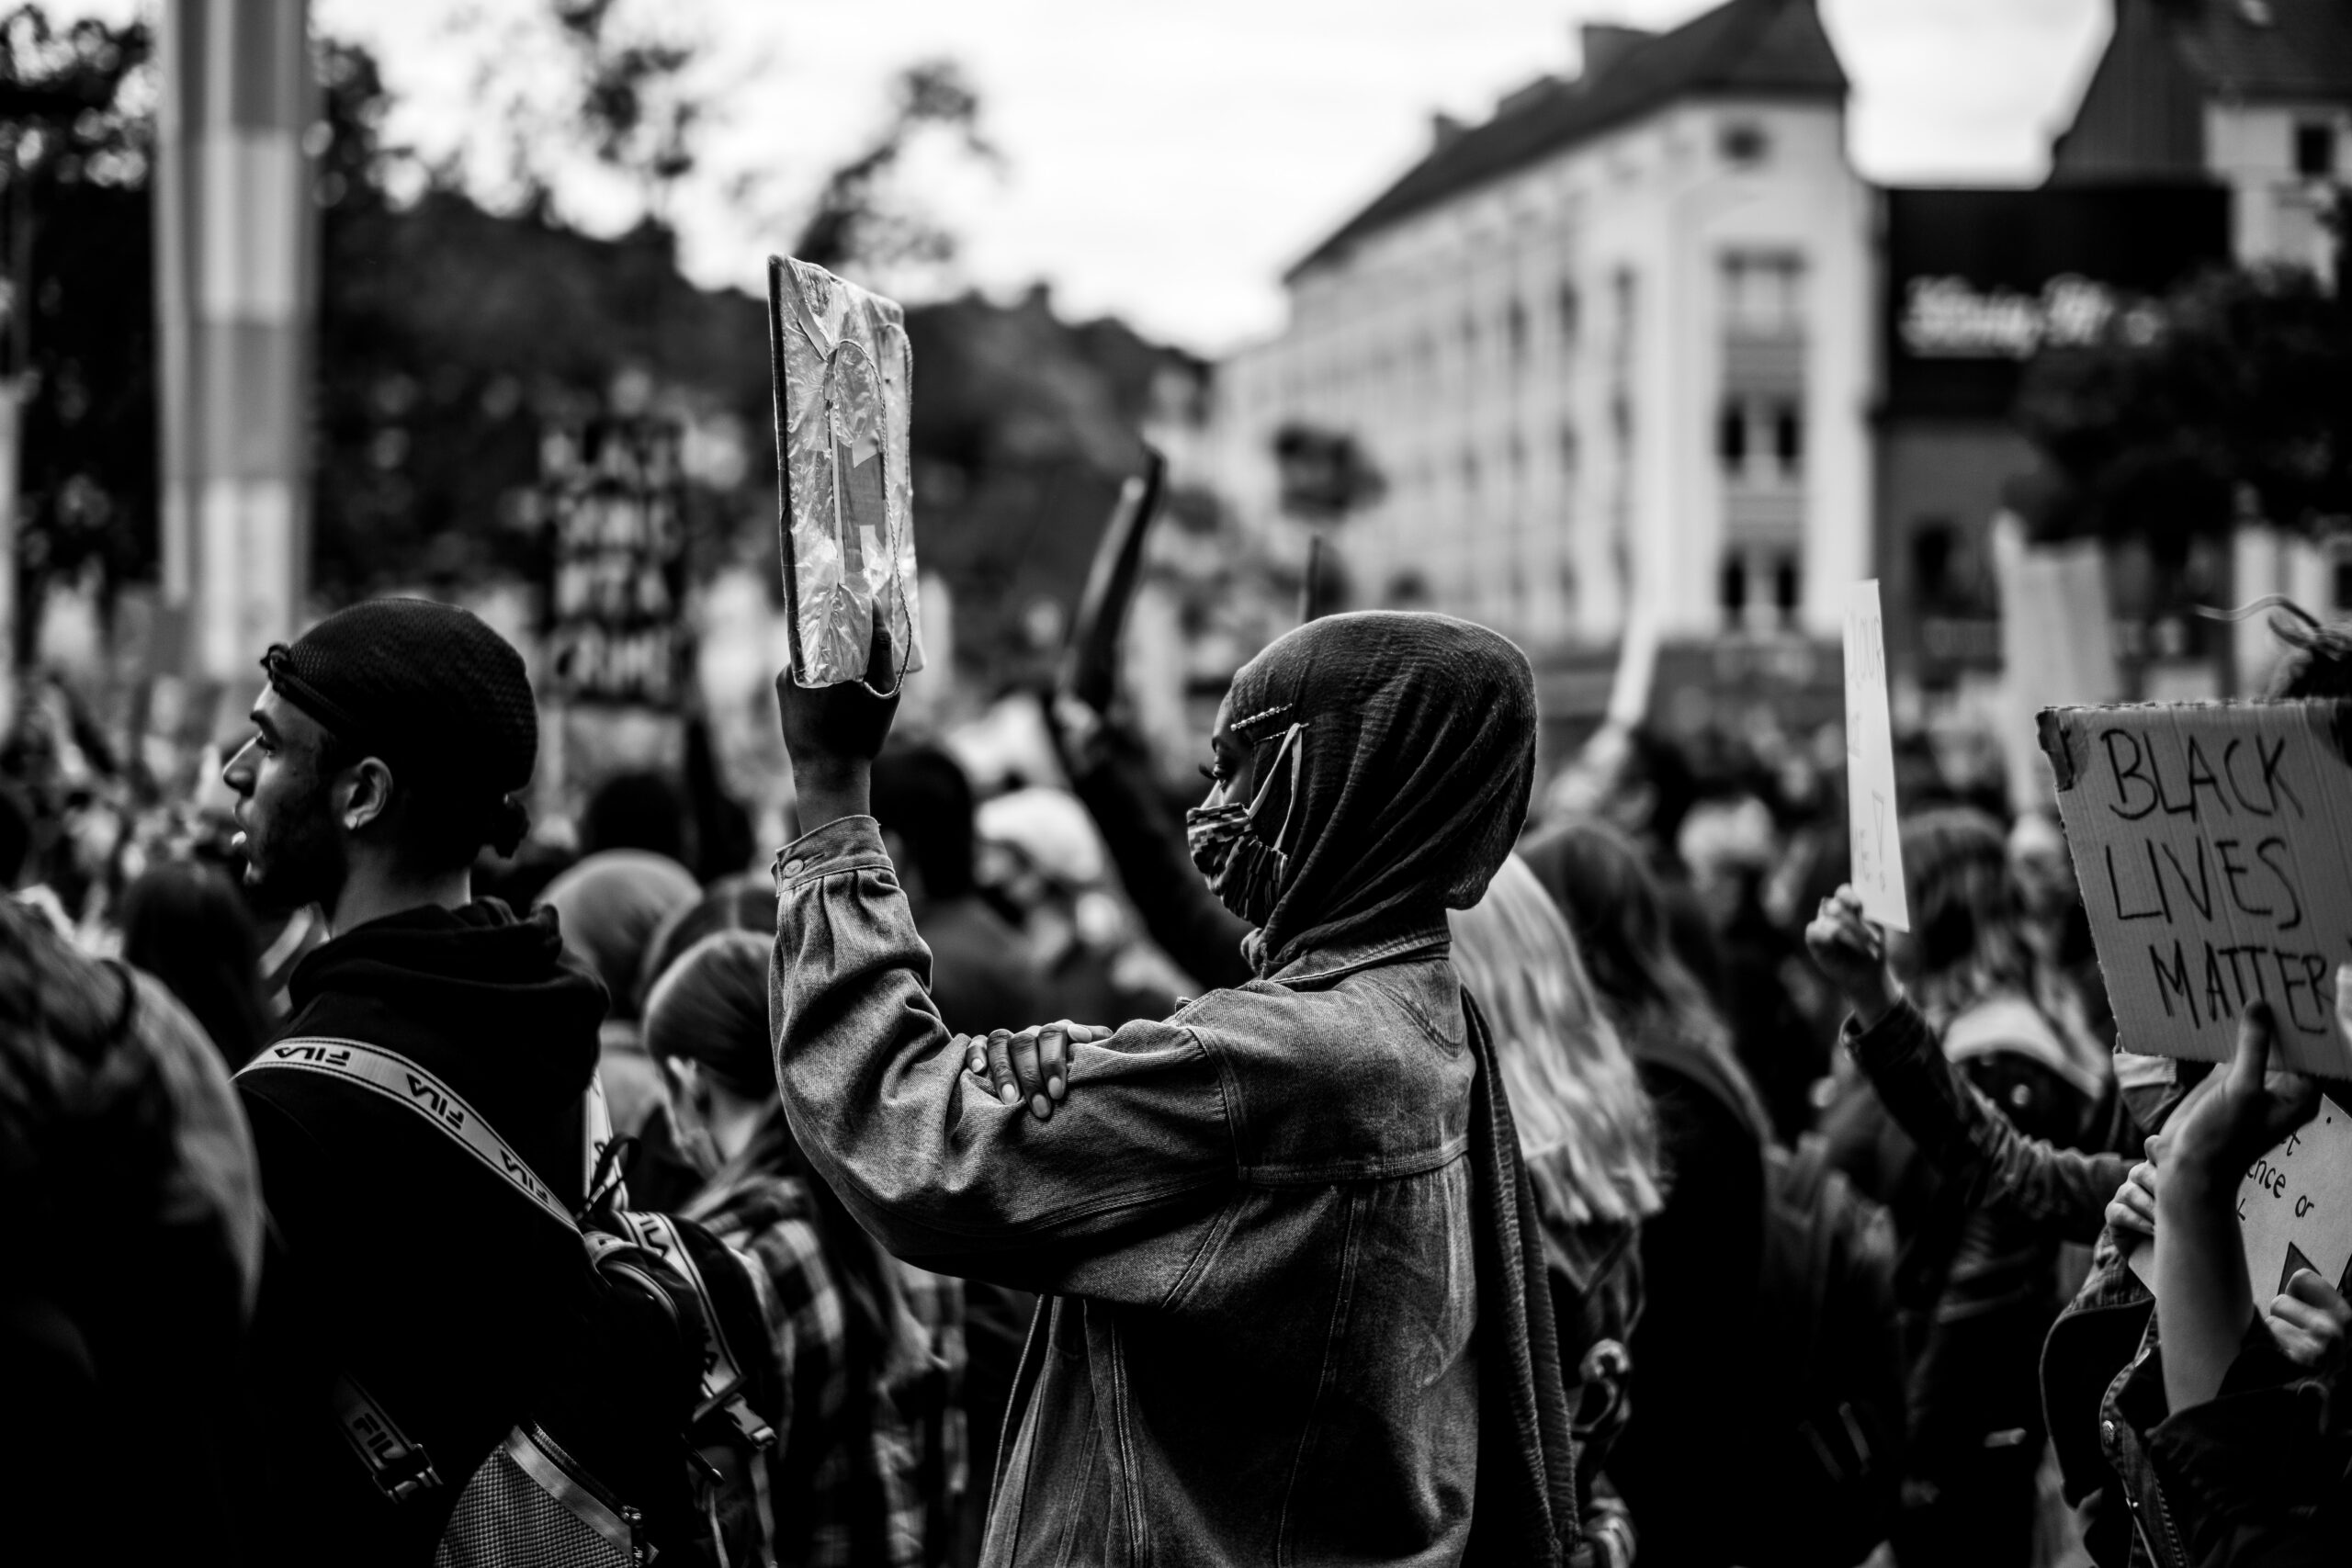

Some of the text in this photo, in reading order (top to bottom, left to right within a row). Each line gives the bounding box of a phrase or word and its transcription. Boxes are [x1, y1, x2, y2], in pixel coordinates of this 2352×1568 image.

[2100, 728, 2304, 823] BLACK
[2105, 835, 2302, 931] LIVES
[2148, 939, 2335, 1036] MATTER
[274, 1046, 352, 1067] FILA
[406, 1072, 465, 1131] FILA
[2294, 1194, 2315, 1218] or
